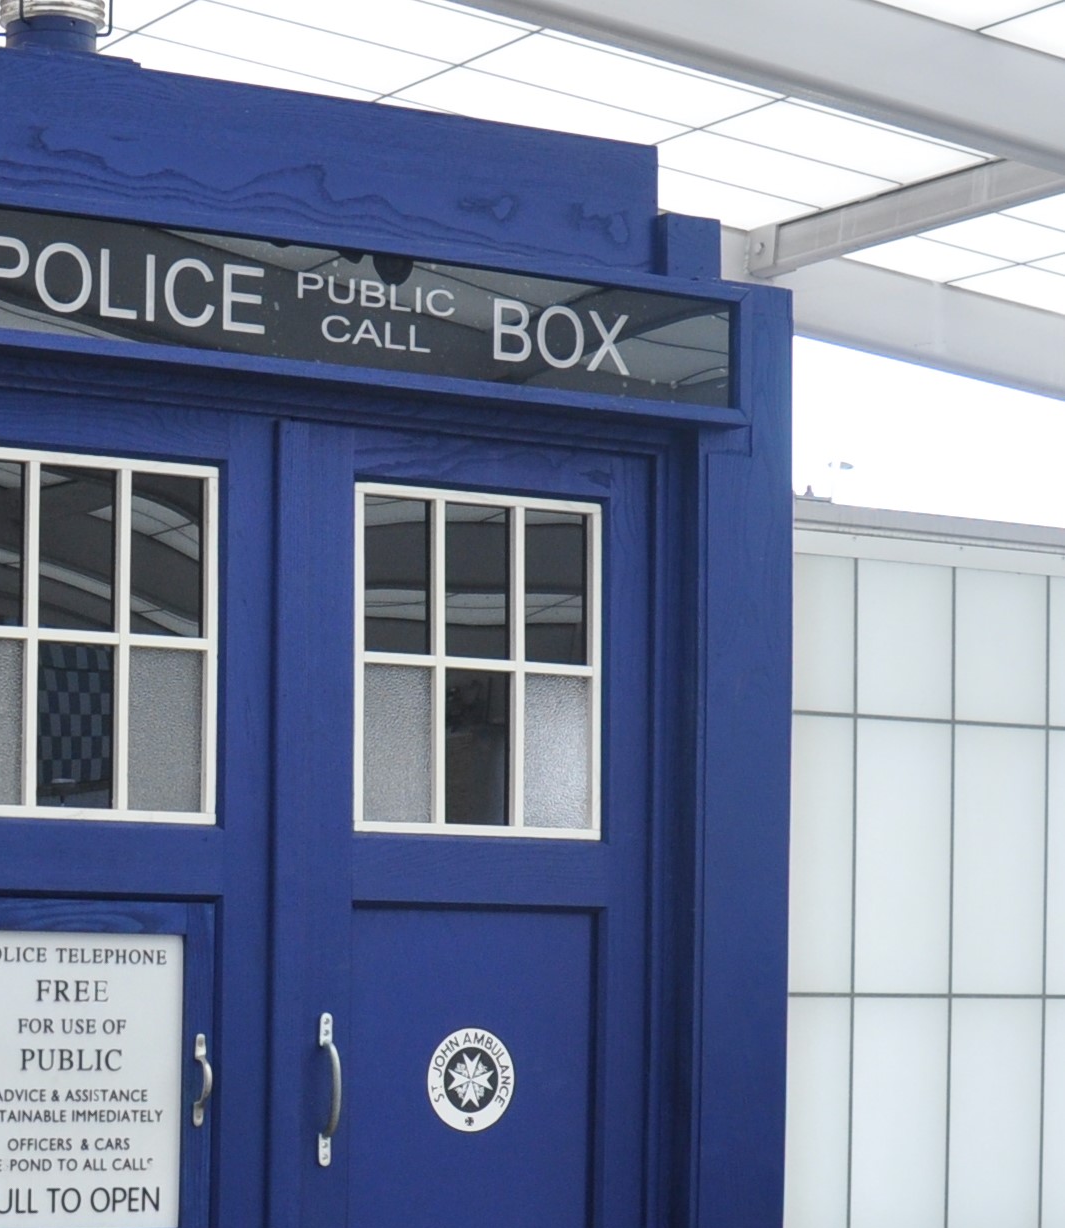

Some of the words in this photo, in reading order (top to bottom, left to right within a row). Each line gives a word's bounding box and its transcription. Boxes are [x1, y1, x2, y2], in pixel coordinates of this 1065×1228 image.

[296, 271, 457, 318] PUBLIC
[321, 314, 432, 354] CALL
[492, 297, 630, 376] BOX
[55, 948, 168, 966] TELEPHONE
[35, 979, 110, 1002] FREE
[17, 1018, 55, 1035] FOR
[61, 1018, 97, 1035] USE
[102, 1018, 127, 1035] OF
[20, 1049, 123, 1072] PUBLIC
[432, 1036, 460, 1078] JOHN
[462, 1031, 512, 1108] AMBULANCE
[50, 1089, 61, 1102] &
[65, 1089, 148, 1102] ASSISTANCE
[71, 1110, 163, 1123] IMMEDIATELY
[7, 1138, 73, 1151] OFFICERS
[80, 1138, 90, 1151] &
[94, 1138, 131, 1151] CARS
[57, 1158, 78, 1172] TO
[82, 1158, 108, 1172] ALL
[47, 1187, 82, 1214] TO
[90, 1187, 161, 1213] OPEN
